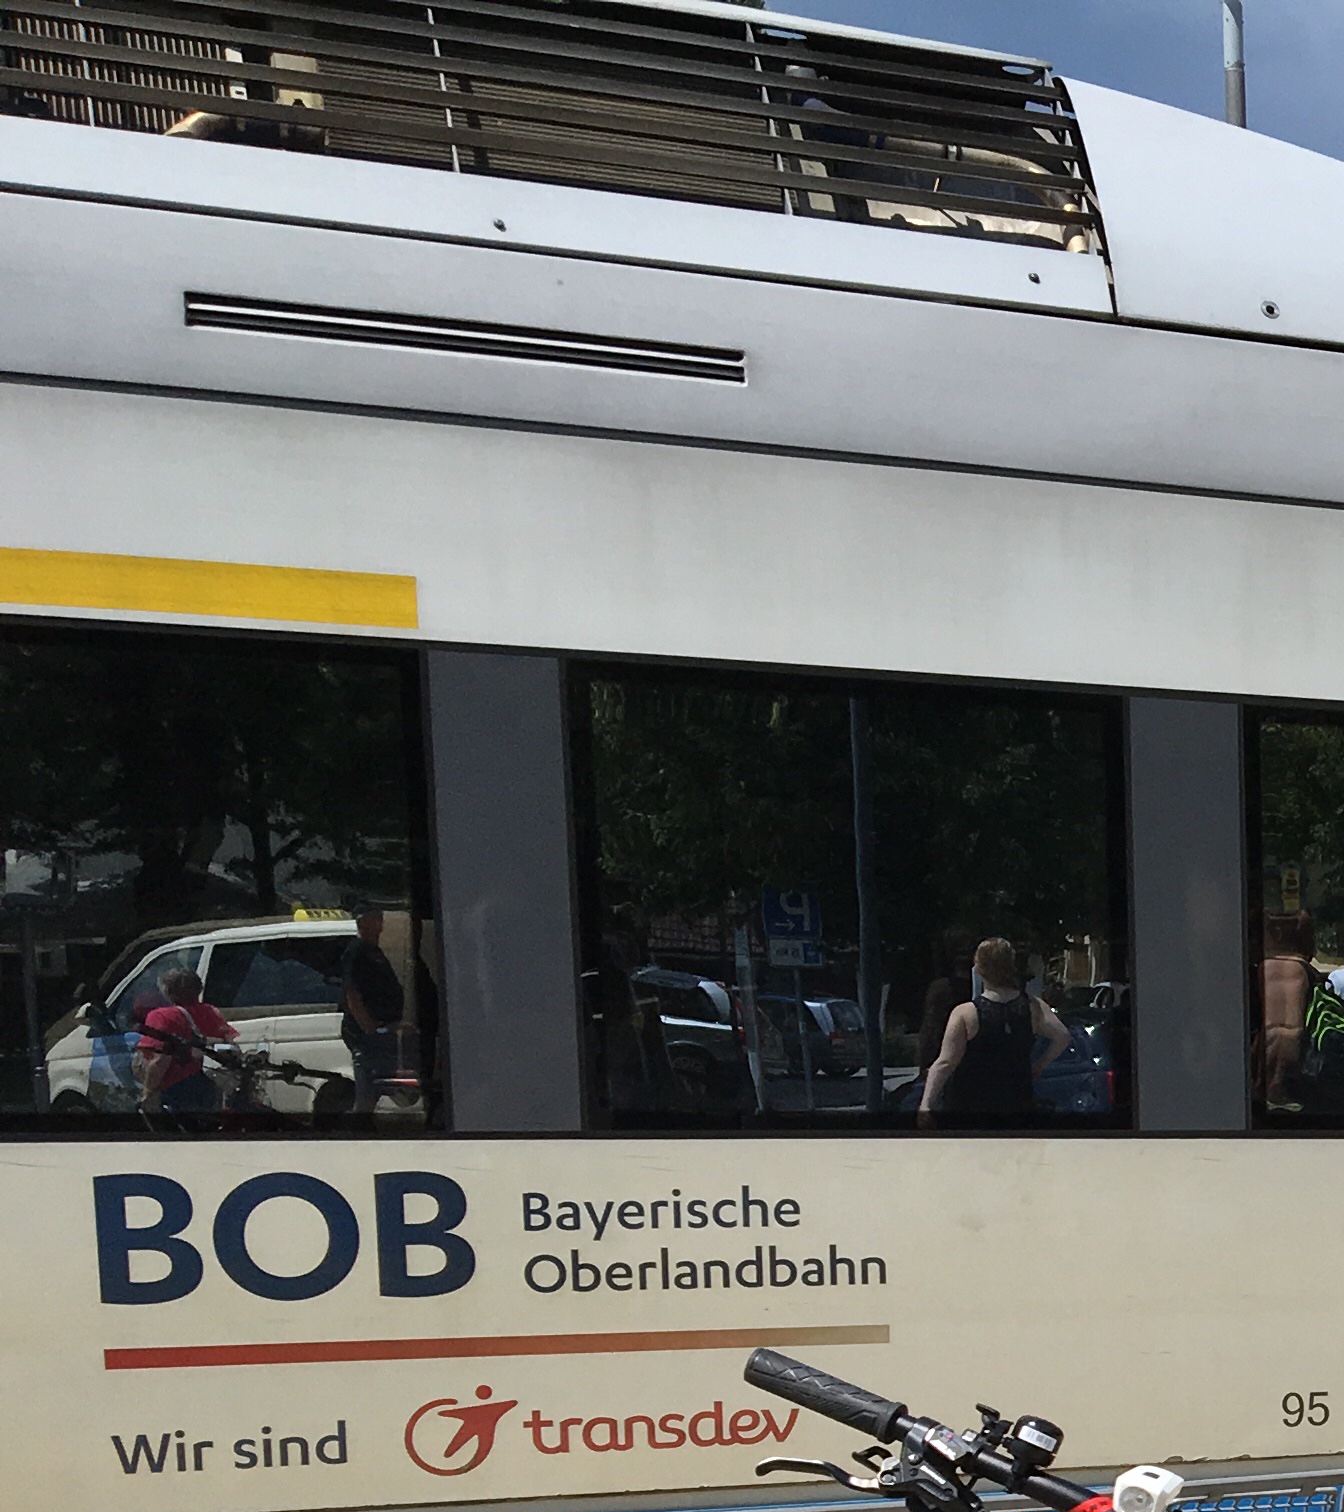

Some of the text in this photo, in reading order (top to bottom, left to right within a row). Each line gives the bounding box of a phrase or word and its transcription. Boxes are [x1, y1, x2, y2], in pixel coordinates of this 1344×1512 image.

[93, 1170, 477, 1306] BOB
[522, 1186, 803, 1241] Bayerische
[524, 1244, 889, 1295] Oberlandbahn
[1281, 1391, 1331, 1428] 95
[111, 1399, 801, 1476] Wir sind transdev
